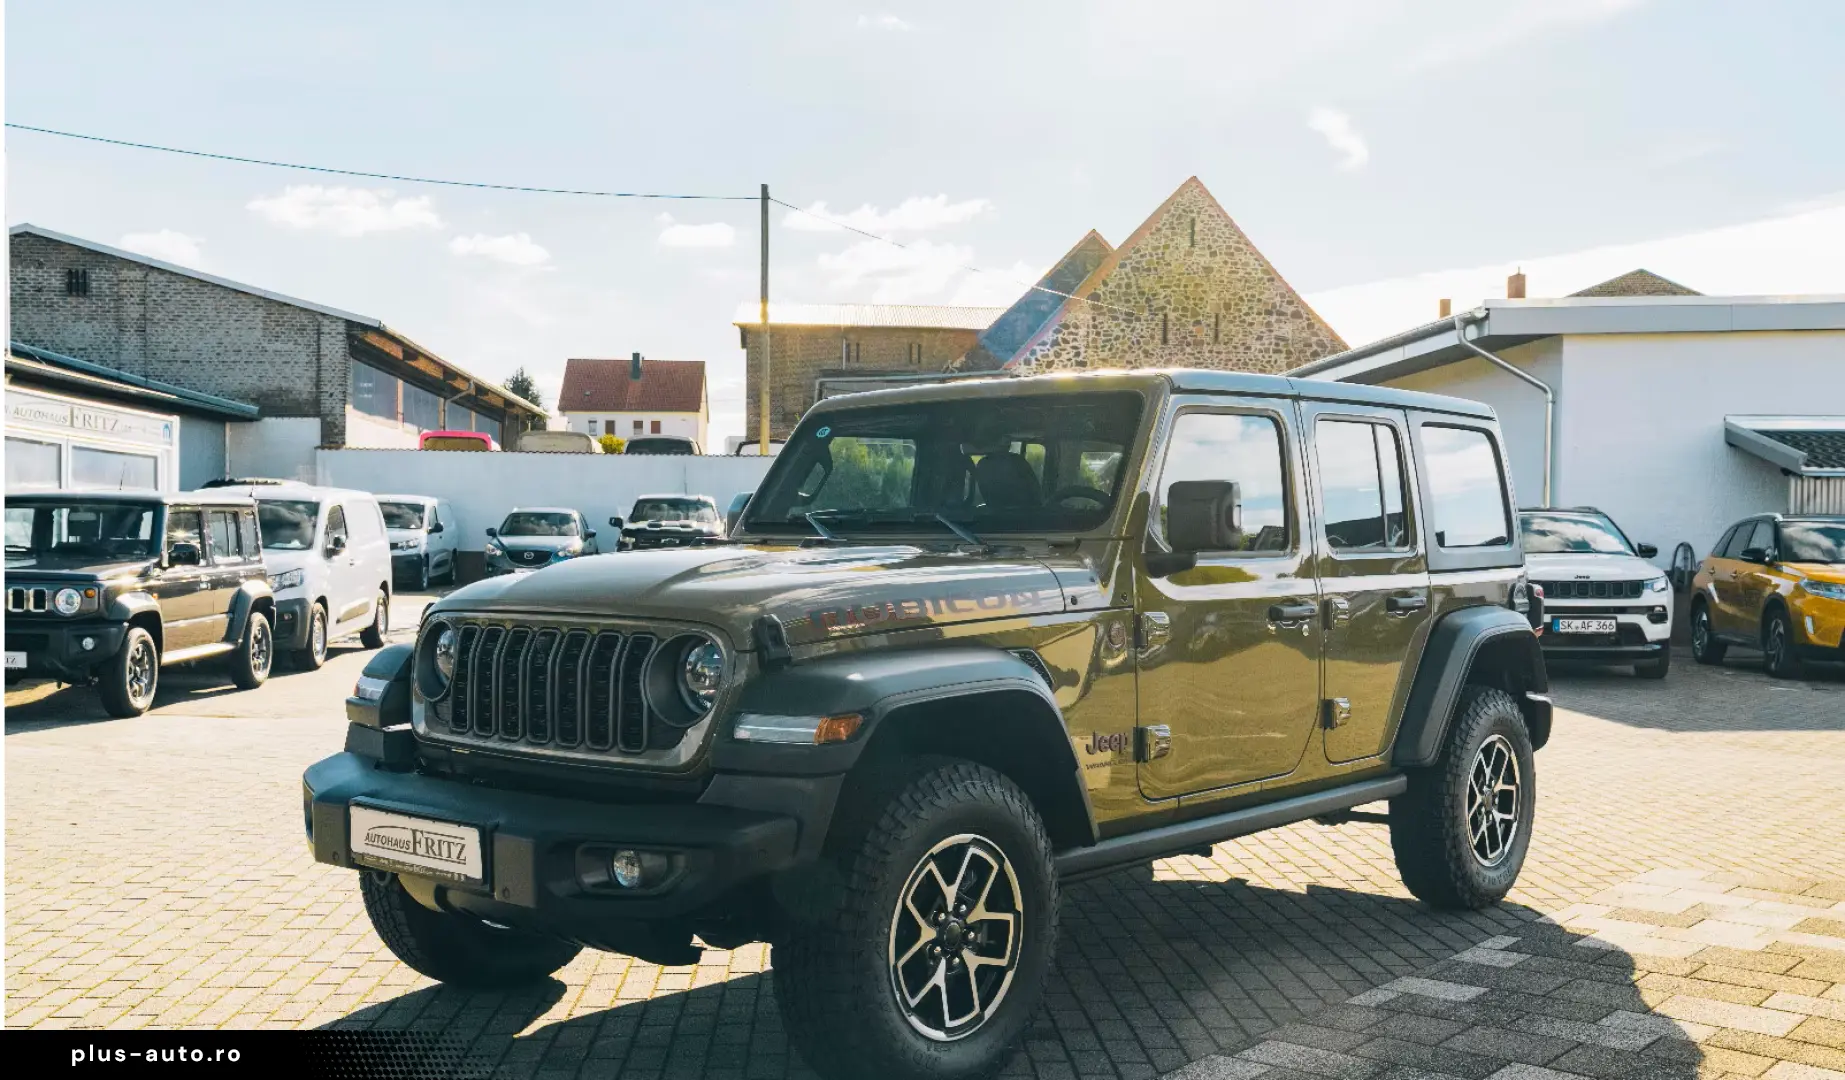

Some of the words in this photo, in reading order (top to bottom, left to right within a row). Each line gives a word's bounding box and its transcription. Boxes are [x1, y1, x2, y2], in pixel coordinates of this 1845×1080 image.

[13, 406, 68, 424] AUTOHAUS
[69, 406, 119, 431] FRITZ
[807, 591, 1041, 632] RUBICON
[1560, 620, 1574, 630] SK
[1581, 620, 1594, 630] AF
[1595, 620, 1615, 630] 366
[1085, 730, 1128, 755] Jeep
[364, 832, 412, 851] AUTOHAUS
[410, 828, 467, 861] FRITZ
